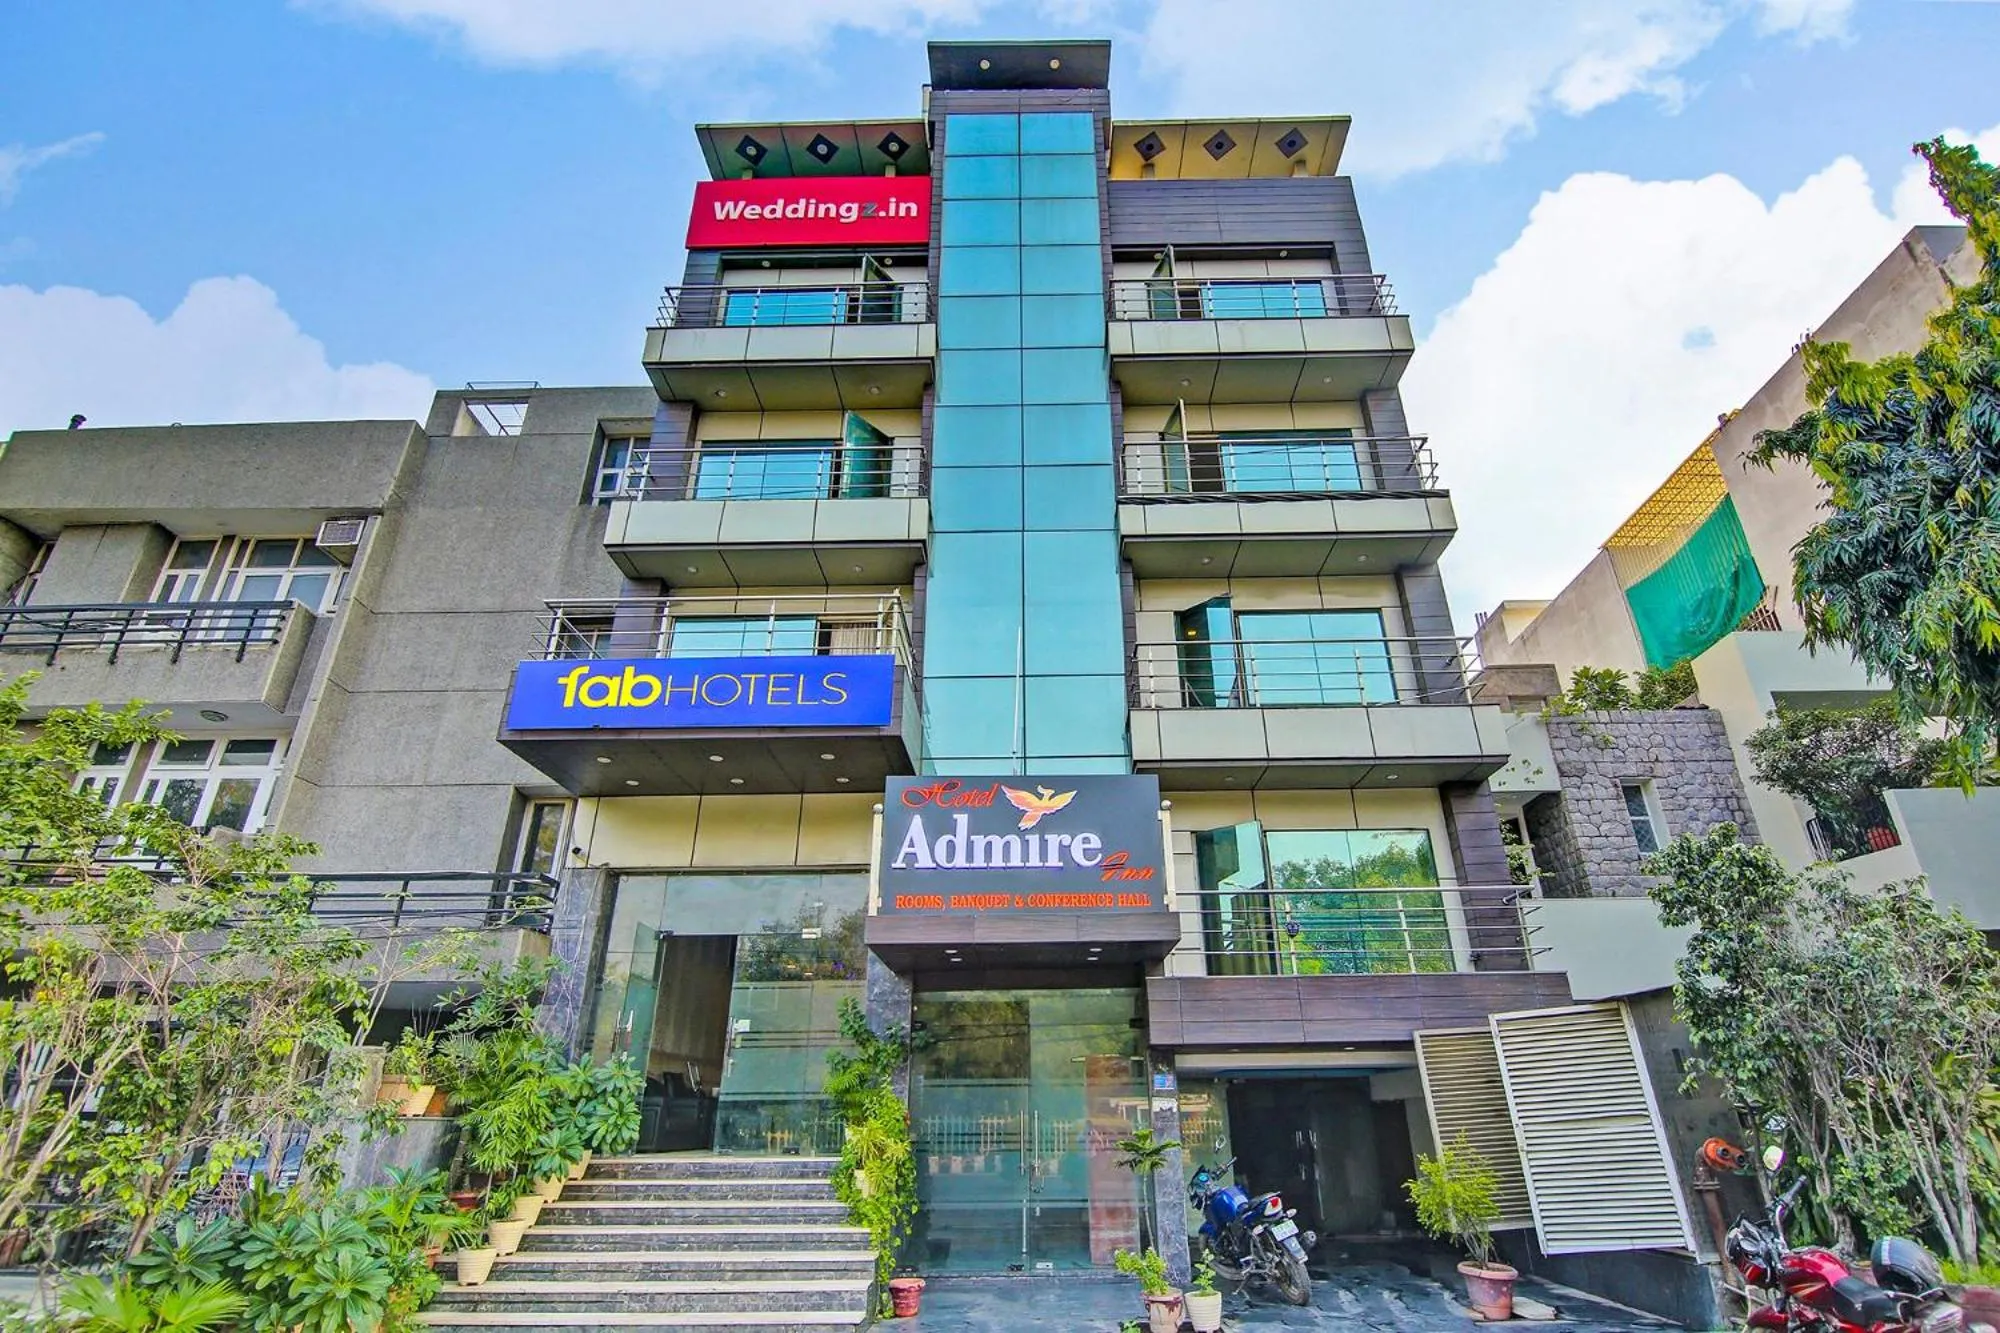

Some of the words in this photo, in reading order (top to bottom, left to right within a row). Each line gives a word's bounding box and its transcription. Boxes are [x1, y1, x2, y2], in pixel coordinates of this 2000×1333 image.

[713, 197, 918, 223] Weddingz.in
[902, 779, 999, 809] Hotel
[891, 813, 1102, 869] Admire
[1100, 851, 1156, 882] Inn
[895, 895, 946, 911] ROOMS,
[951, 894, 1010, 911] BANQUET
[1014, 894, 1026, 908] &
[1027, 893, 1114, 909] CONFERENCE
[1118, 893, 1152, 907] HALL
